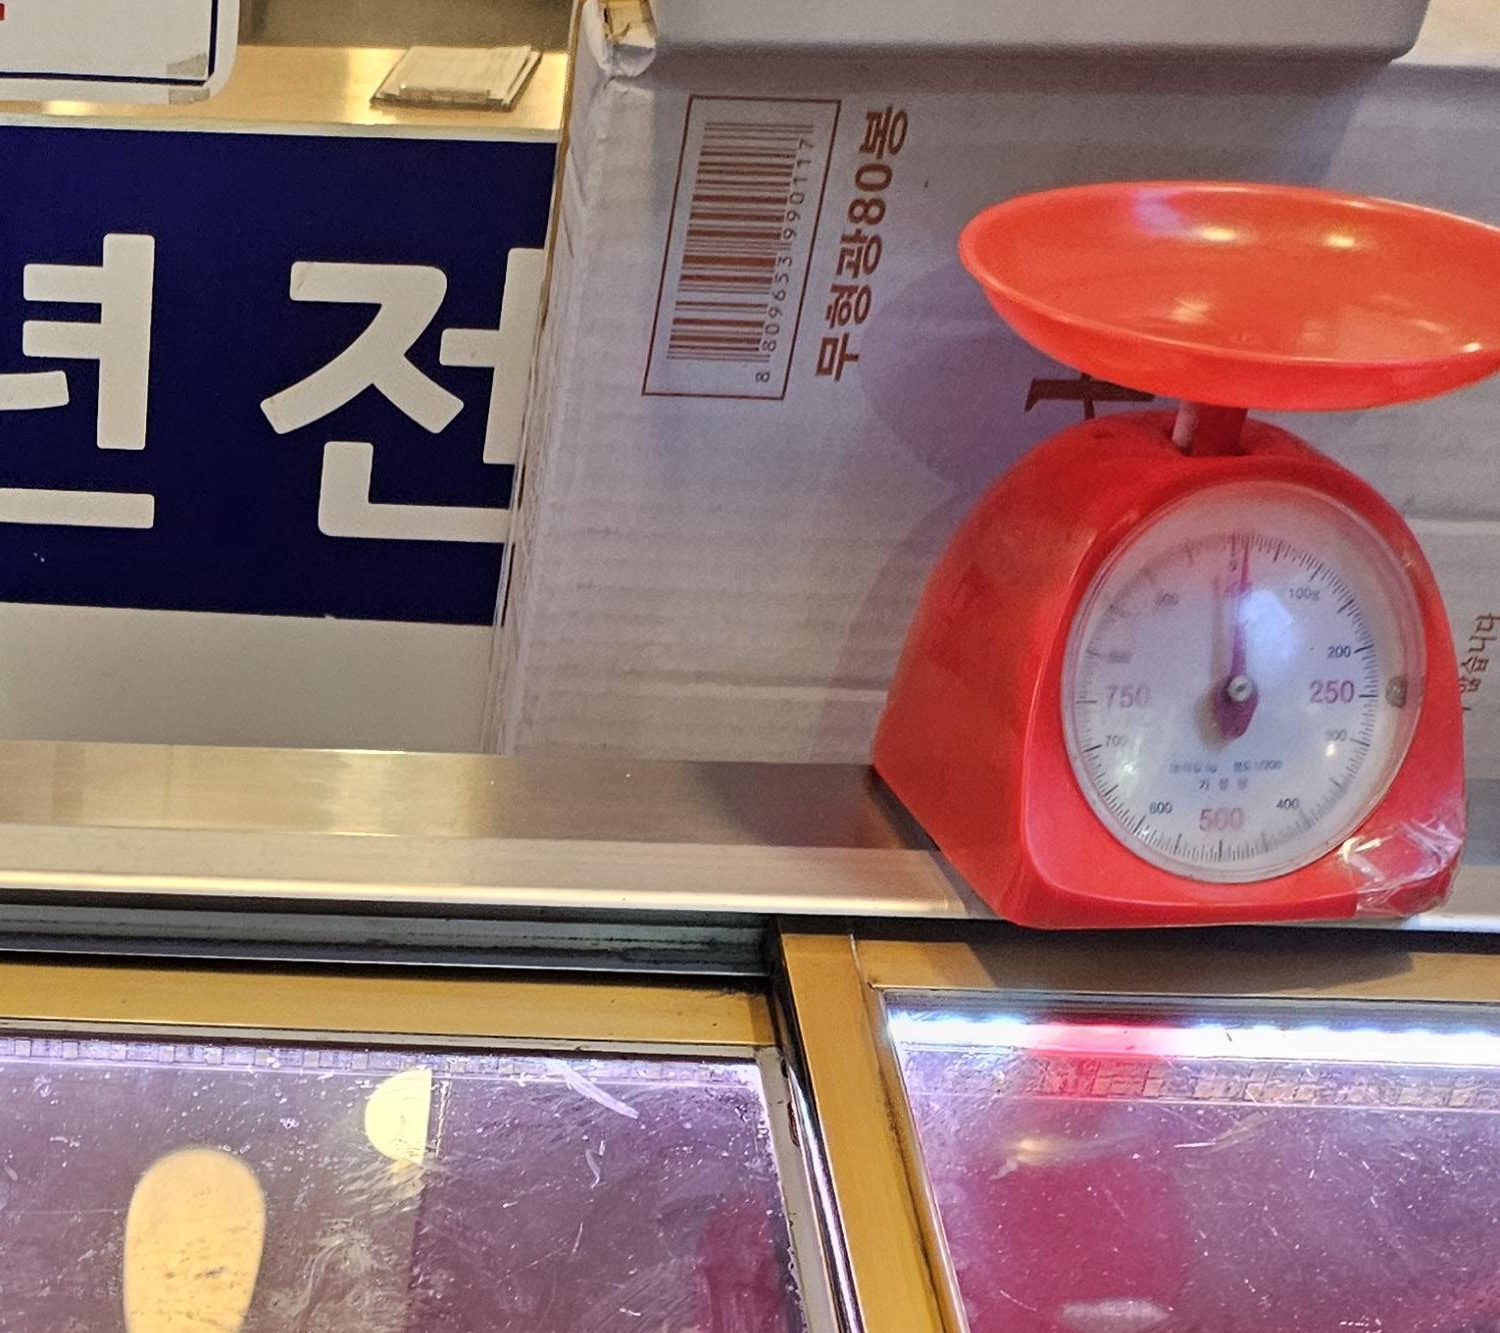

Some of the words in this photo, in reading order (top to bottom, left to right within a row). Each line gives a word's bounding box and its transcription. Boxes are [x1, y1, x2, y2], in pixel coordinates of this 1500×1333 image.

[814, 104, 909, 384] 무형광80봉
[1327, 645, 1352, 659] 200
[1105, 684, 1150, 708] 750
[1309, 681, 1355, 704] 250
[1276, 798, 1300, 811] 400
[1199, 807, 1246, 832] 500
